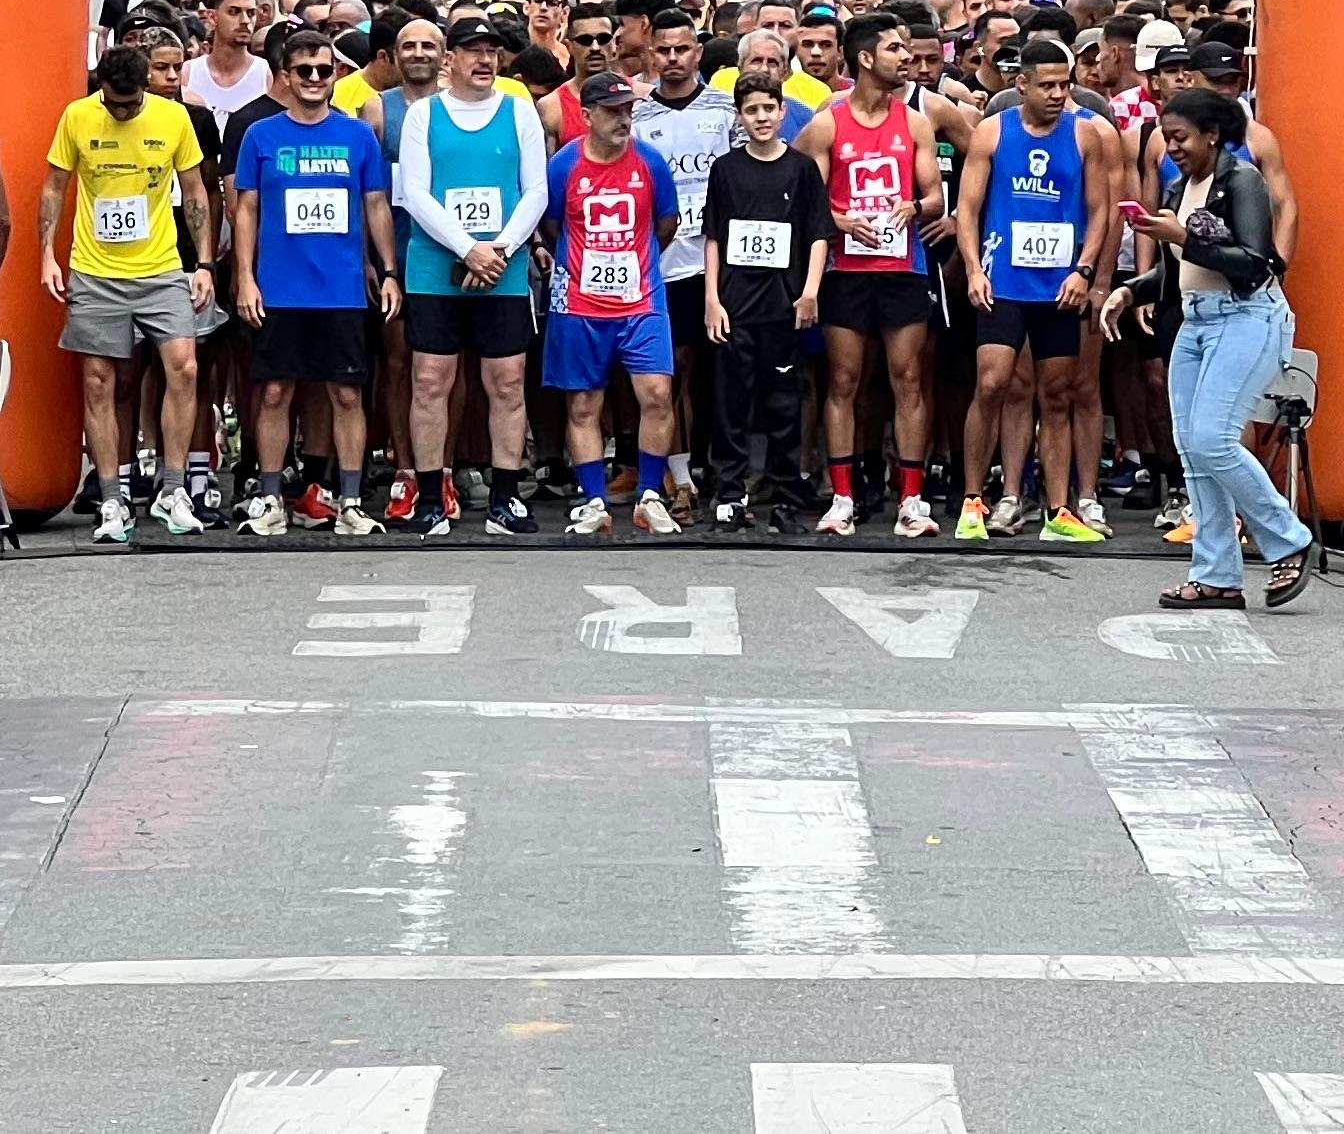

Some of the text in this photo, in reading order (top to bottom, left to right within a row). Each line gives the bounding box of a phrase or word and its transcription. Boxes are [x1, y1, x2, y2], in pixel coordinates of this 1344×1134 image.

[1012, 176, 1061, 195] WILL
[101, 211, 136, 230] 136
[297, 203, 335, 221] 046
[454, 202, 490, 221] 129
[739, 235, 776, 254] 183
[1022, 237, 1060, 256] 407
[591, 266, 628, 284] 283
[292, 584, 1281, 665] PARE
